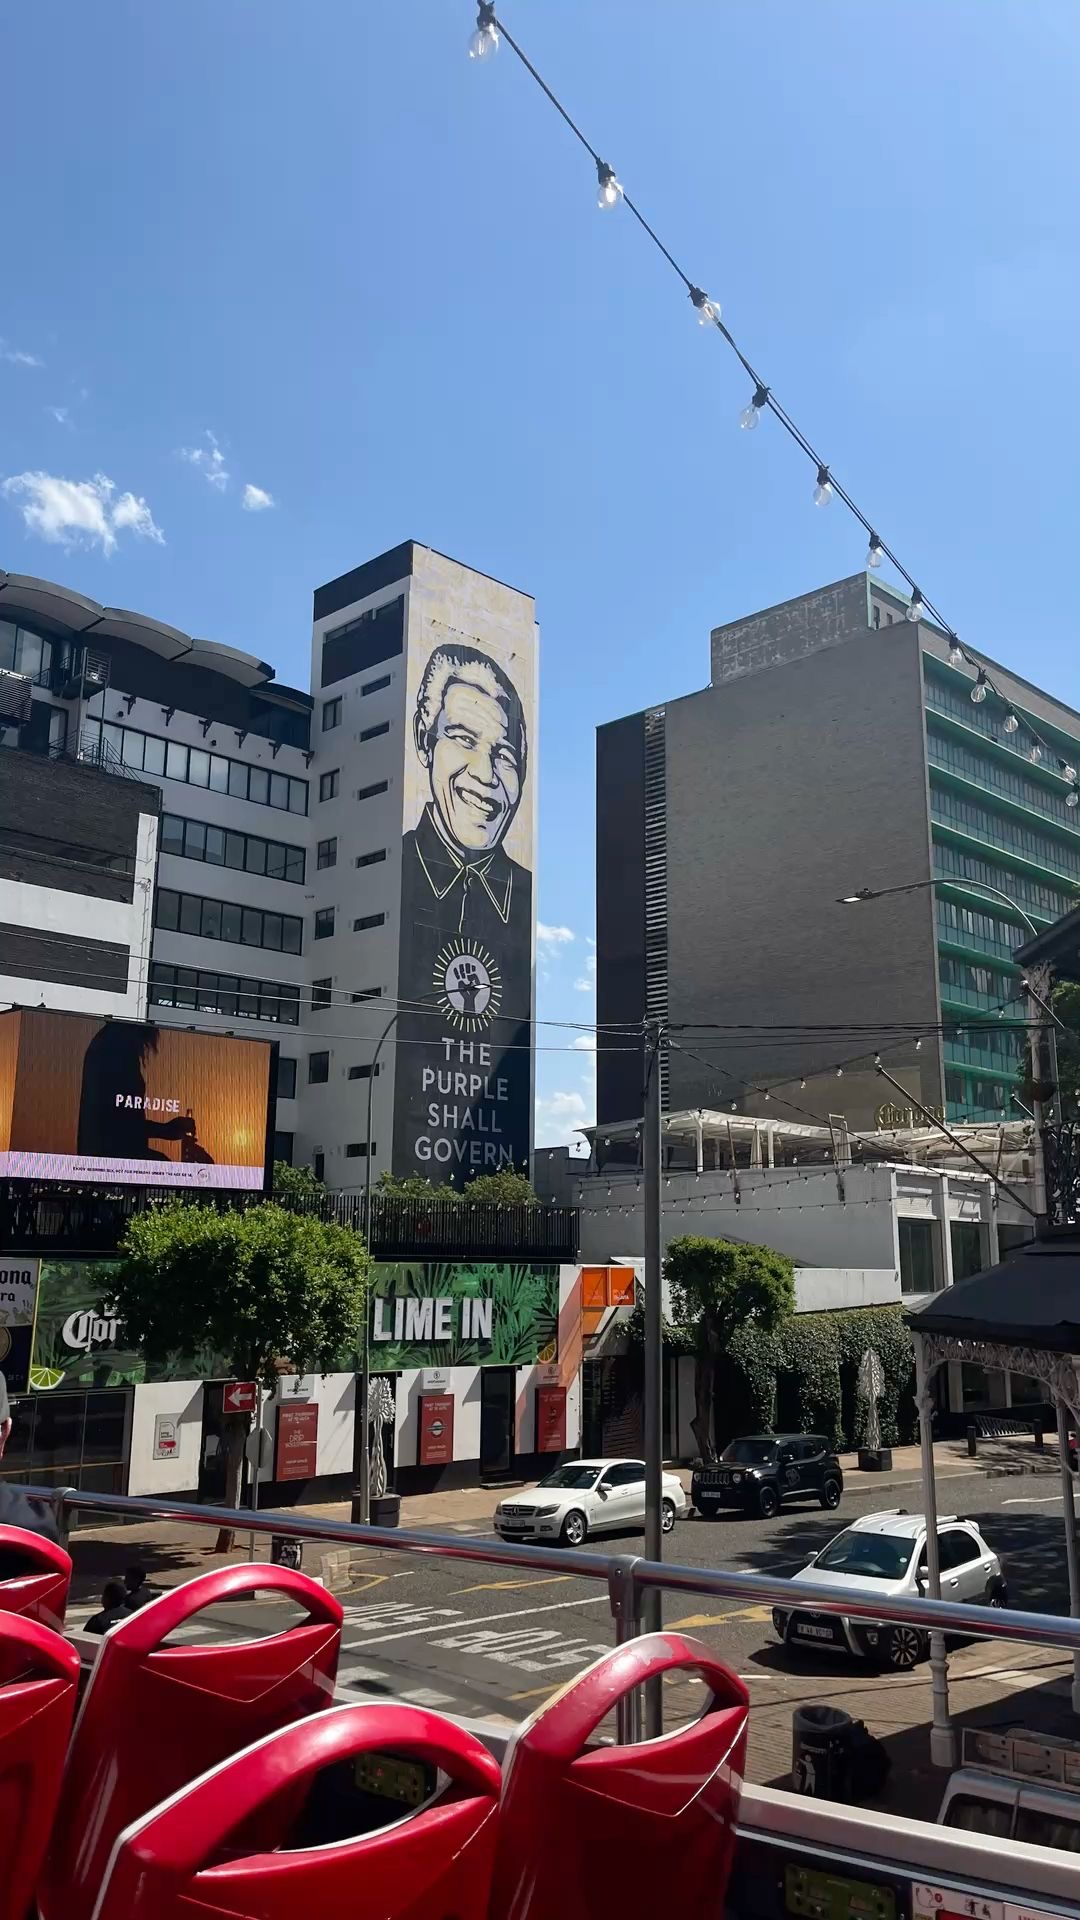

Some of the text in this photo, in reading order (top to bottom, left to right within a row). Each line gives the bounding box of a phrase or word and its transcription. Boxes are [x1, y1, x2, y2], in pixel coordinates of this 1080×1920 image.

[441, 1037, 491, 1066] THE
[422, 1068, 509, 1101] PURPLE
[115, 1094, 181, 1113] PARADISE
[427, 1103, 502, 1133] SHALL
[414, 1136, 513, 1166] GOVERN
[373, 1297, 493, 1341] LIME IN
[427, 1627, 614, 1673] STOP
